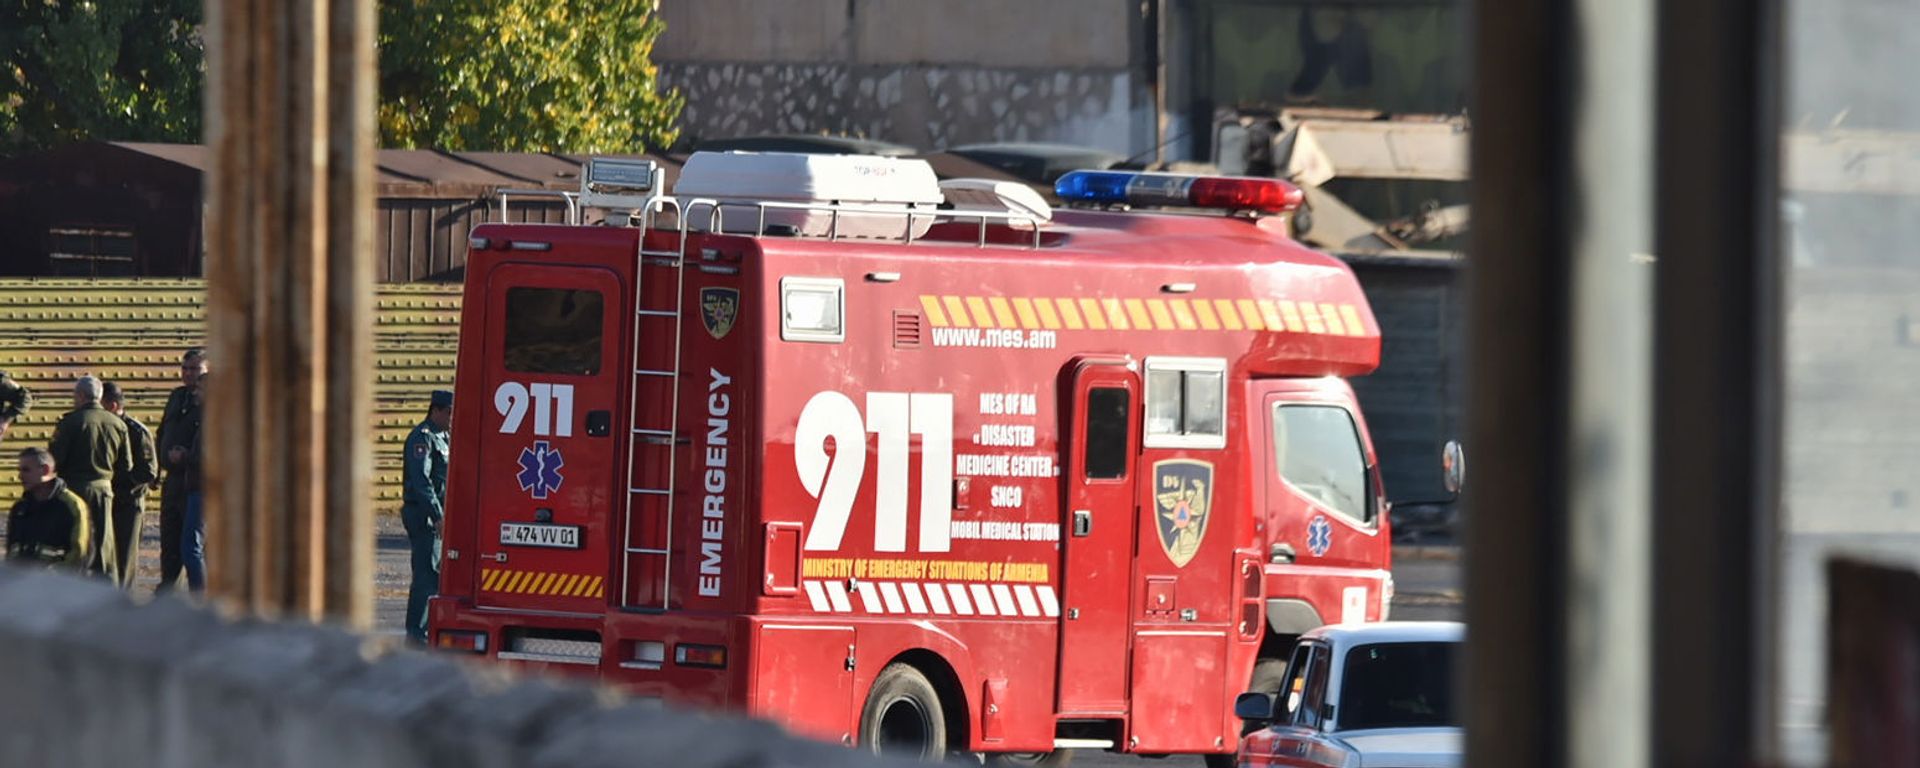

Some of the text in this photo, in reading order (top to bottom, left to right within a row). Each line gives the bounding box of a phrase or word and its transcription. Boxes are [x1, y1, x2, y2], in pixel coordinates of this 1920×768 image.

[931, 328, 1056, 348] www.mes.am
[494, 381, 574, 437] 911
[980, 393, 1003, 414] MES
[1004, 393, 1019, 415] OF
[794, 391, 953, 552] 911
[956, 454, 1010, 476] MEDICINE
[1011, 455, 1052, 477] CENTER
[699, 367, 731, 596] EMERGENCY
[516, 527, 538, 543] 474
[541, 528, 558, 544] VV
[561, 529, 575, 545] 01
[951, 521, 980, 539] MOBIL
[981, 521, 1022, 540] MEDICAL
[803, 558, 1049, 583] MINISTRY OF EMERGENCY SITUATIONS OF ARMENIA
